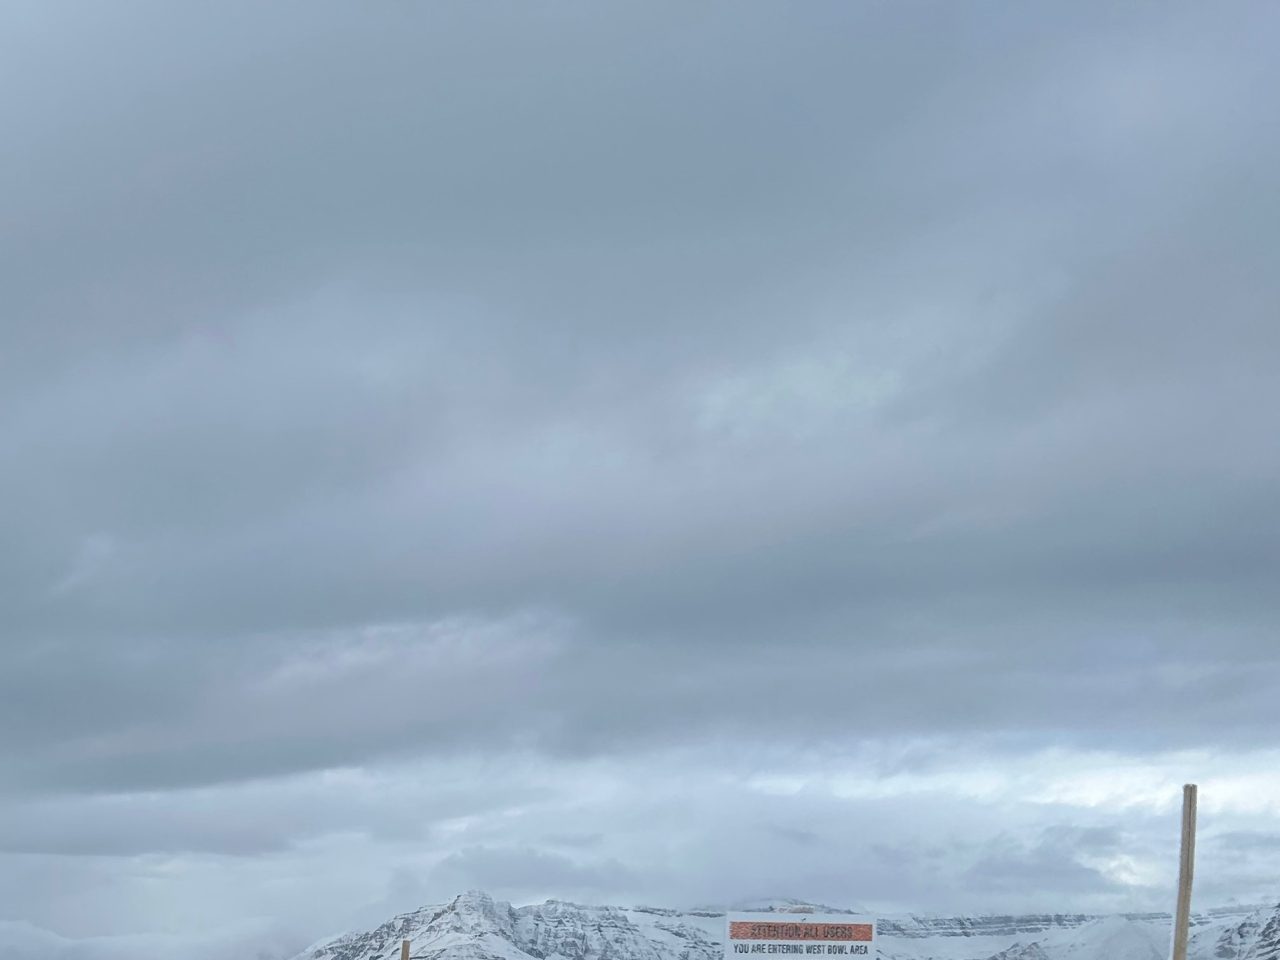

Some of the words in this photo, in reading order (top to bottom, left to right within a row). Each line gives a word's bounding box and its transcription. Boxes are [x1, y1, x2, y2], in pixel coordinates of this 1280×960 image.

[733, 944, 749, 953] YOU
[751, 944, 767, 953] ARE
[767, 944, 803, 954] ENTERING
[805, 944, 825, 954] WEST
[827, 945, 848, 954] BOWL
[850, 945, 868, 954] AREA
